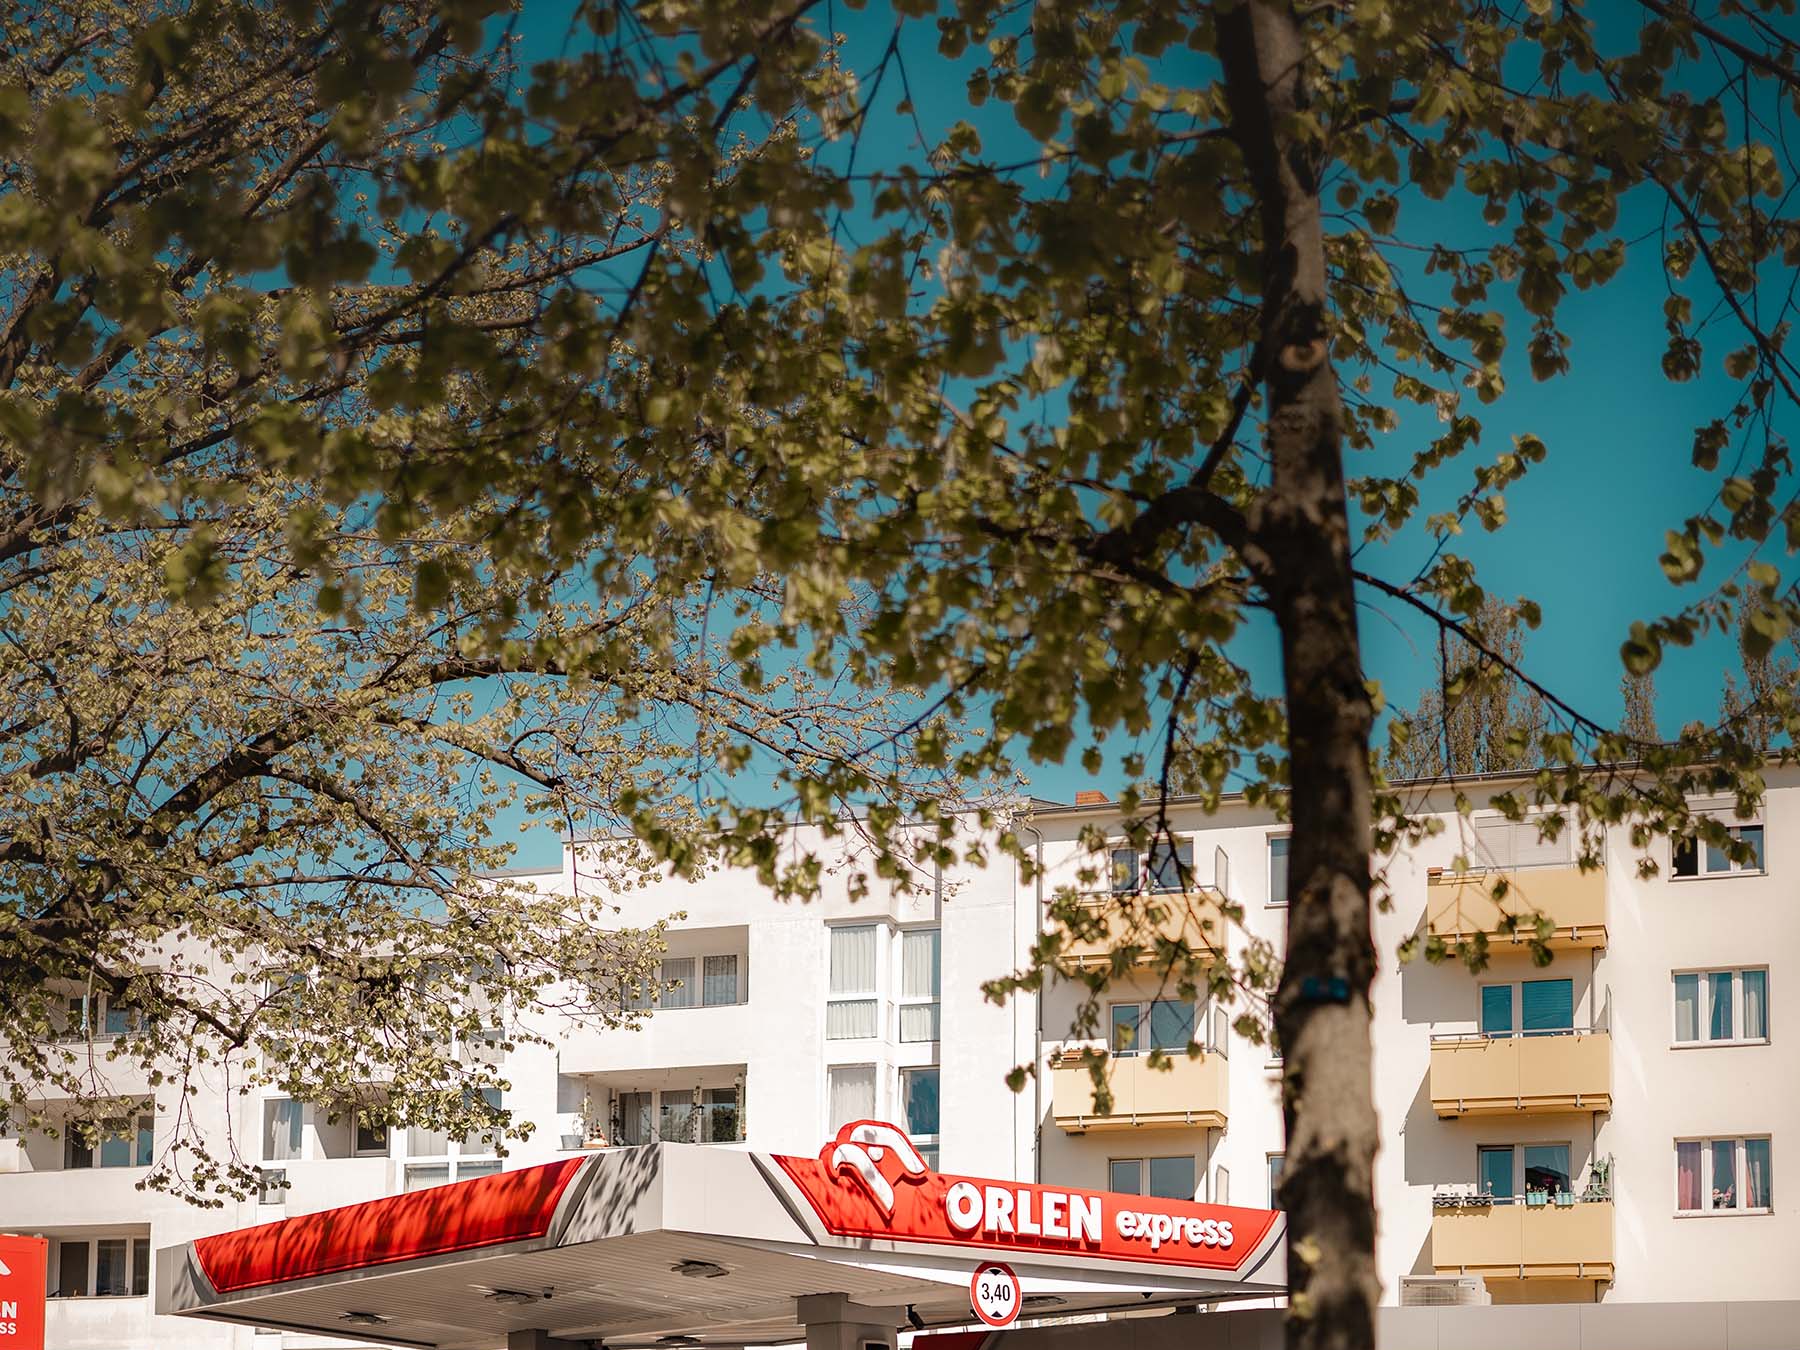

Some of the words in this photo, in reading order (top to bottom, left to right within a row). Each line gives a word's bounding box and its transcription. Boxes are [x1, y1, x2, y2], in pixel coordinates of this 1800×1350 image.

[946, 1181, 1102, 1243] ORLEN
[1116, 1209, 1234, 1249] express
[981, 1282, 1011, 1304] 3,40
